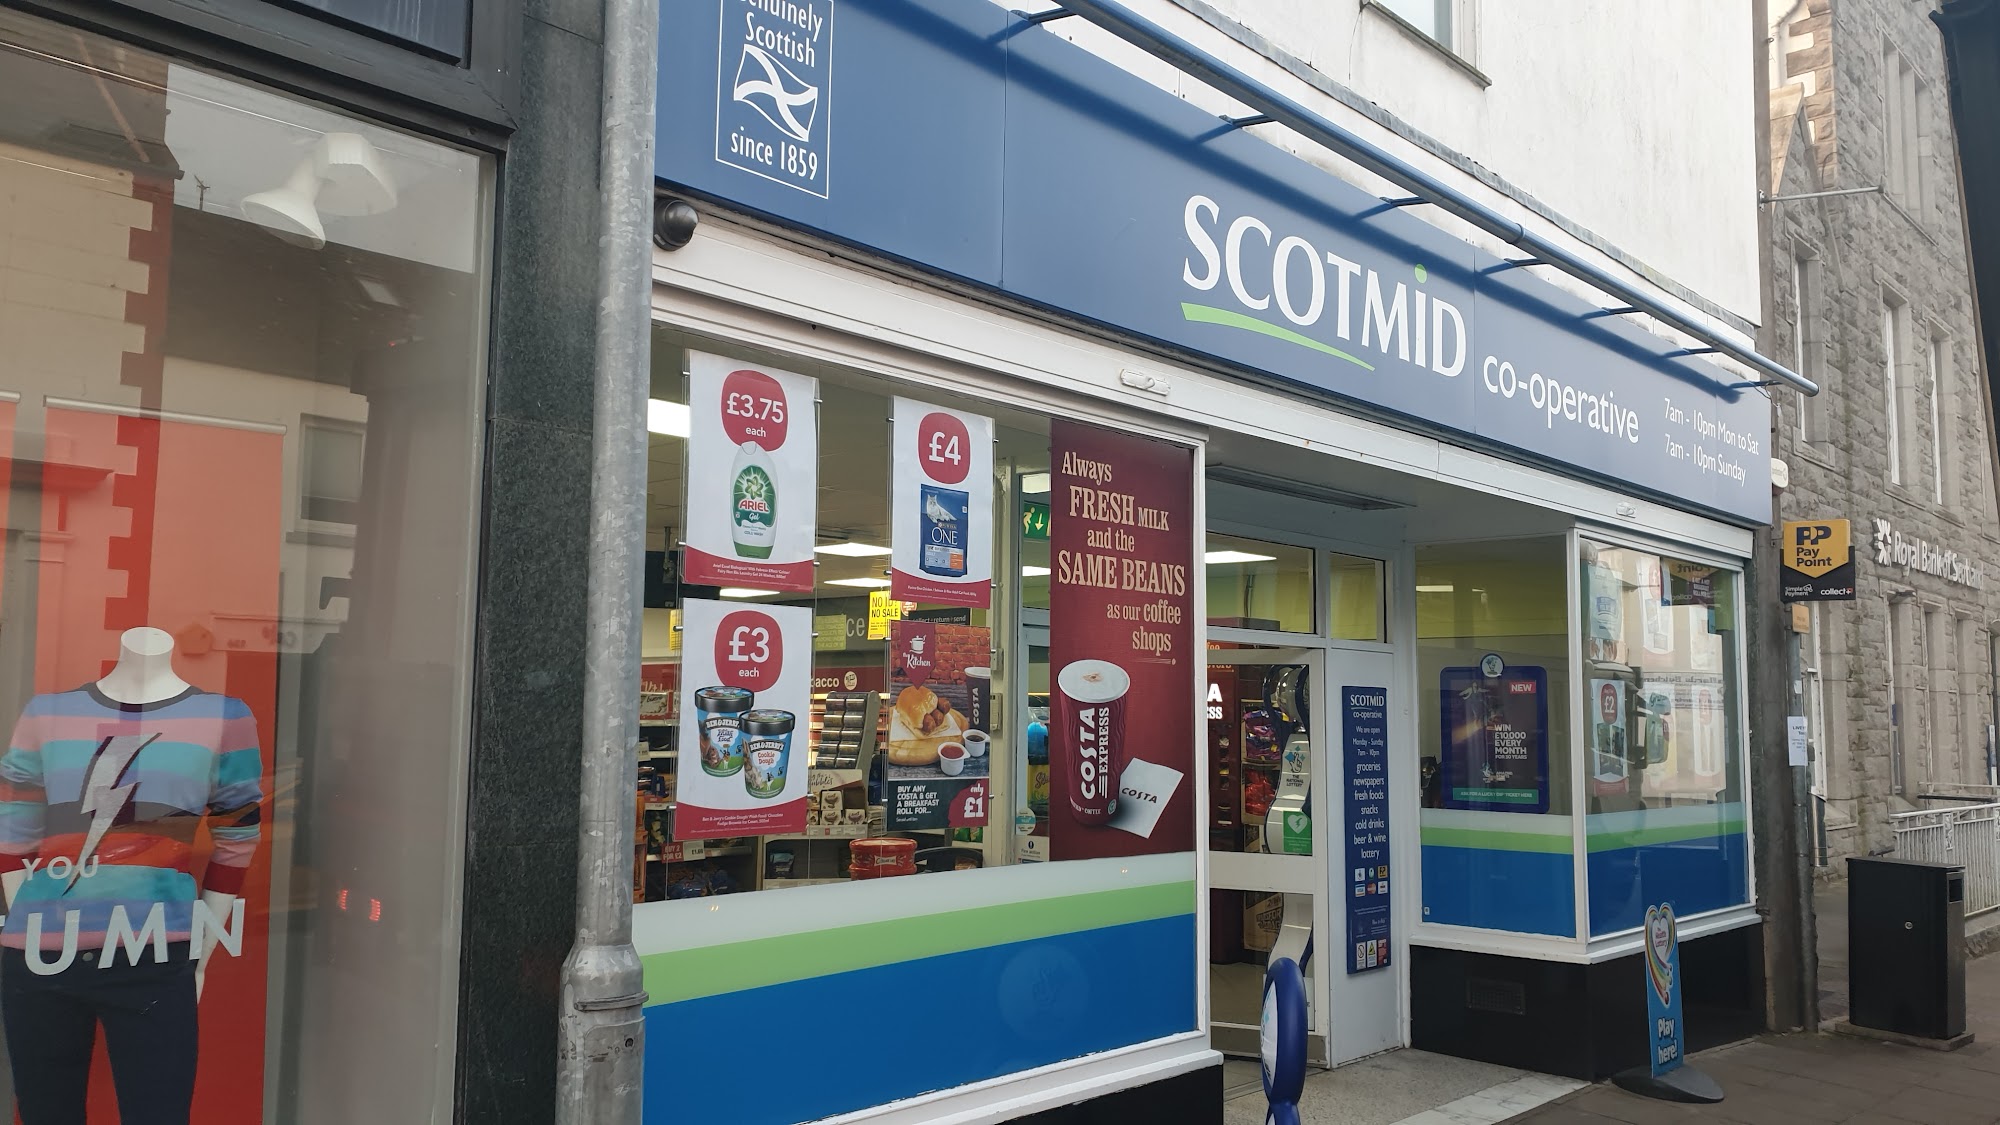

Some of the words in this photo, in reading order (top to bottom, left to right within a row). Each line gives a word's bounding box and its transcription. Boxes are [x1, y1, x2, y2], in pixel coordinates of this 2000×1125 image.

[746, 11, 815, 68] Scottish
[730, 126, 773, 166] since
[780, 141, 818, 180] 1859
[1483, 355, 1639, 443] co-operative
[726, 392, 784, 424] £3.75
[745, 426, 767, 438] each
[1664, 398, 1684, 425] 7am
[1694, 410, 1716, 440] 10pm
[1718, 420, 1736, 446] Mon
[1738, 434, 1746, 450] to
[1748, 433, 1759, 455] Sat
[929, 431, 961, 466] £4
[1061, 451, 1112, 485] Always
[1664, 433, 1684, 460] 7am
[1694, 444, 1716, 474] 10pm
[1718, 454, 1746, 487] Sunday
[740, 500, 769, 512] ARIEL
[1069, 485, 1135, 526] FRESH
[1138, 506, 1170, 532] MILK
[932, 527, 958, 545] ONE
[1087, 527, 1112, 549] and
[1114, 528, 1135, 552] the
[1796, 547, 1820, 558] Pay
[1895, 531, 1920, 577] Royal
[1922, 541, 1942, 578] Bank
[1796, 557, 1832, 567] Point
[1058, 550, 1117, 589] SAME
[1122, 558, 1186, 597] BEANS
[872, 597, 883, 607] NO
[871, 608, 881, 618] NO
[882, 608, 898, 617] SALE
[1107, 603, 1120, 619] as
[1122, 604, 1141, 621] our
[1143, 599, 1181, 624] coffee
[728, 626, 770, 663] £3
[1132, 626, 1172, 656] shops
[907, 654, 931, 669] Kitchen
[738, 667, 760, 678] each
[1511, 684, 1532, 692] NEW
[1604, 694, 1614, 713] £2
[1353, 710, 1382, 720] co-operative
[1353, 738, 1367, 747] Monday
[1371, 738, 1384, 747] Sunday
[1495, 747, 1527, 755] MONTH
[1080, 707, 1097, 799] COSTA
[1099, 707, 1110, 773] EXPRESS
[1356, 762, 1381, 774] groceries
[897, 785, 911, 793] BUY
[970, 783, 984, 796] only
[1353, 778, 1385, 788] newspapers
[897, 792, 918, 800] COSTA
[904, 799, 939, 807] BREAKFAST
[1121, 787, 1158, 804] COSTA
[1354, 790, 1368, 800] fresh
[1369, 789, 1384, 800] foods
[964, 797, 984, 818] £1
[1361, 804, 1379, 815] snacks
[1355, 819, 1367, 830] cold
[1368, 818, 1385, 829] drinks
[1353, 834, 1366, 845] beer
[1368, 833, 1372, 843] &
[1374, 832, 1387, 842] wine
[1361, 848, 1380, 860] lottery
[21, 855, 100, 881] YOU
[0, 898, 246, 976] UMN
[1657, 1016, 1675, 1039] Play
[1658, 1039, 1678, 1065] here!
